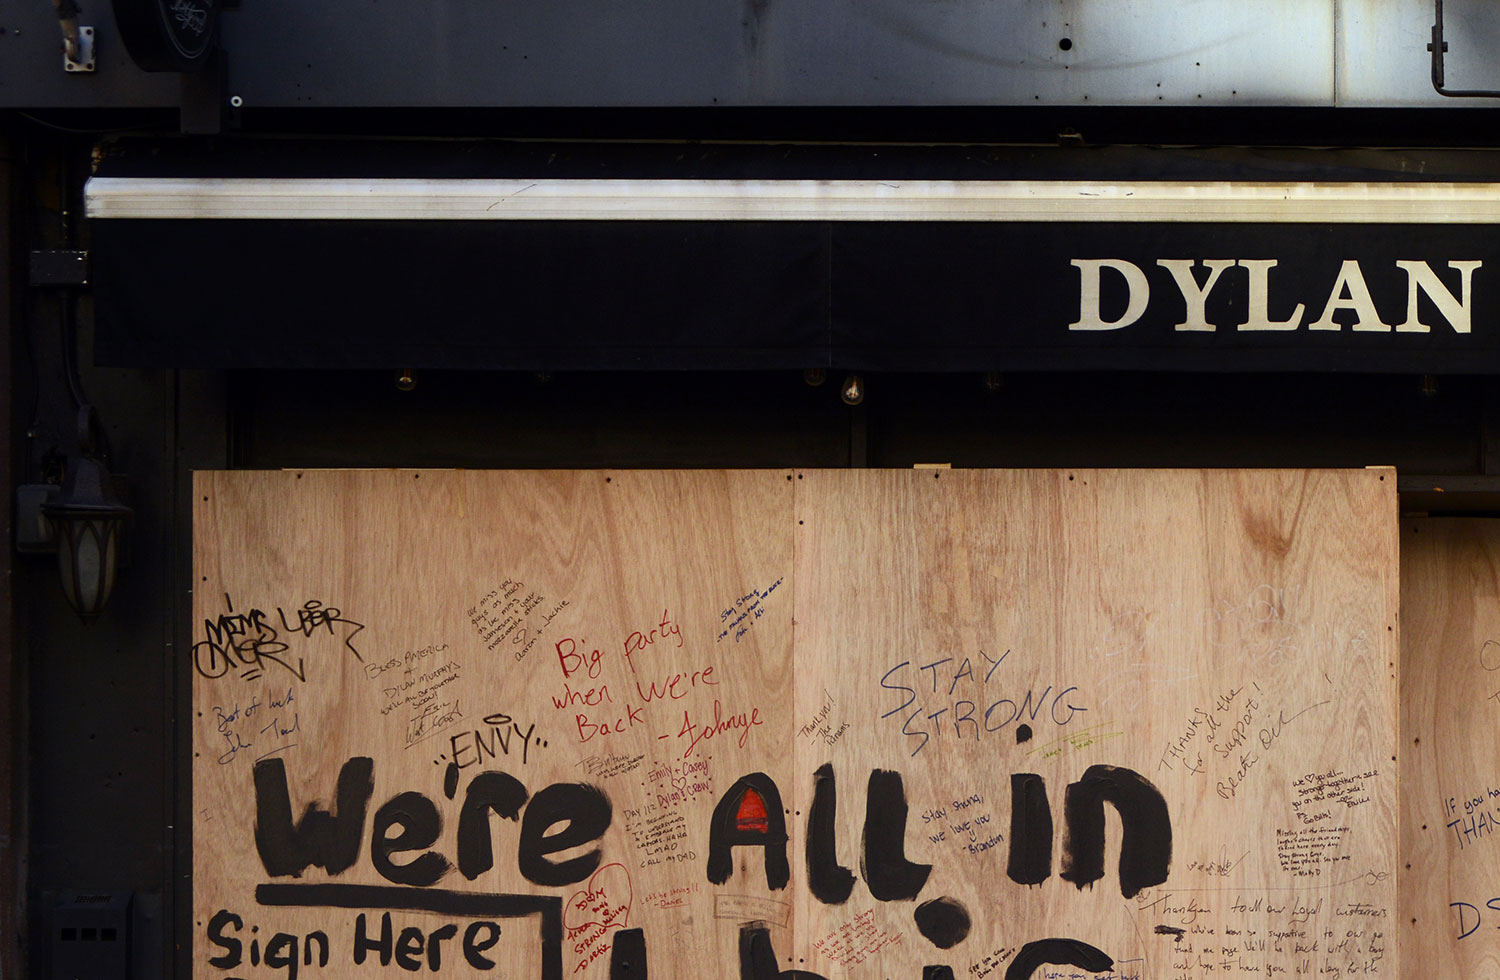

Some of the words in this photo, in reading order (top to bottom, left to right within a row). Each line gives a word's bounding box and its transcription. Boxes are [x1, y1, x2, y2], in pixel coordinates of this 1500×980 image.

[1070, 258, 1482, 333] DYLAN
[500, 578, 512, 591] you
[504, 582, 524, 600] much
[404, 643, 449, 664] AMERICA
[555, 638, 604, 679] Big
[624, 609, 683, 673] party
[384, 678, 416, 699] DYLAN
[881, 650, 1010, 718] STAY
[552, 683, 612, 710] when
[576, 705, 644, 742] Back
[902, 686, 1087, 757] STRONG
[682, 759, 709, 776] Casey
[624, 807, 641, 820] DAY
[1445, 797, 1456, 817] If
[1464, 796, 1484, 815] you
[253, 756, 612, 886] We're
[646, 842, 678, 856] LMAO
[354, 912, 501, 971] Here
